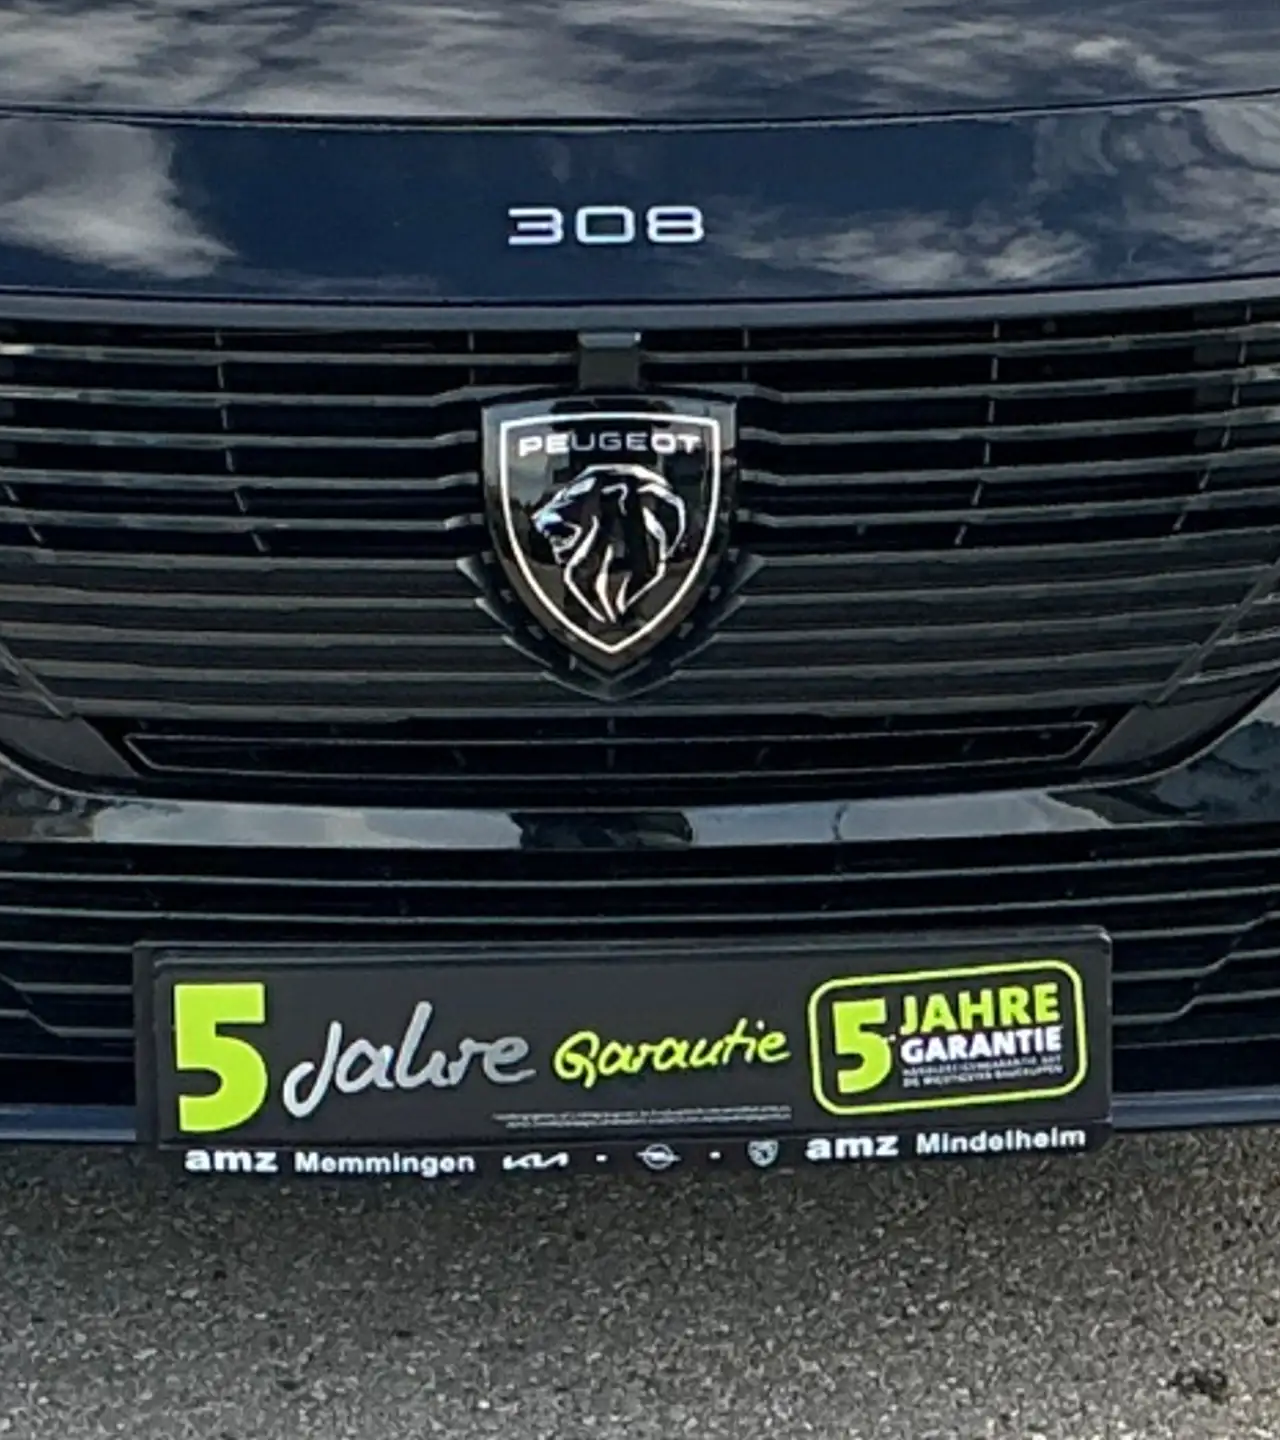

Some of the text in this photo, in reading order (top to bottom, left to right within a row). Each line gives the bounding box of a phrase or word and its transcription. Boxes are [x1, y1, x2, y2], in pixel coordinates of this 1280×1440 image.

[507, 206, 705, 245] 308
[518, 432, 703, 457] PEUGEOT
[899, 982, 1061, 1036] JAHRE
[174, 983, 792, 1133] 5 Jahre Garantie
[831, 998, 892, 1095] 5
[900, 1025, 1063, 1065] GARANTIE
[184, 1148, 279, 1174] amz
[294, 1151, 476, 1179] Memmingen
[805, 1134, 899, 1160] amz
[916, 1126, 1086, 1154] Mindelheim
